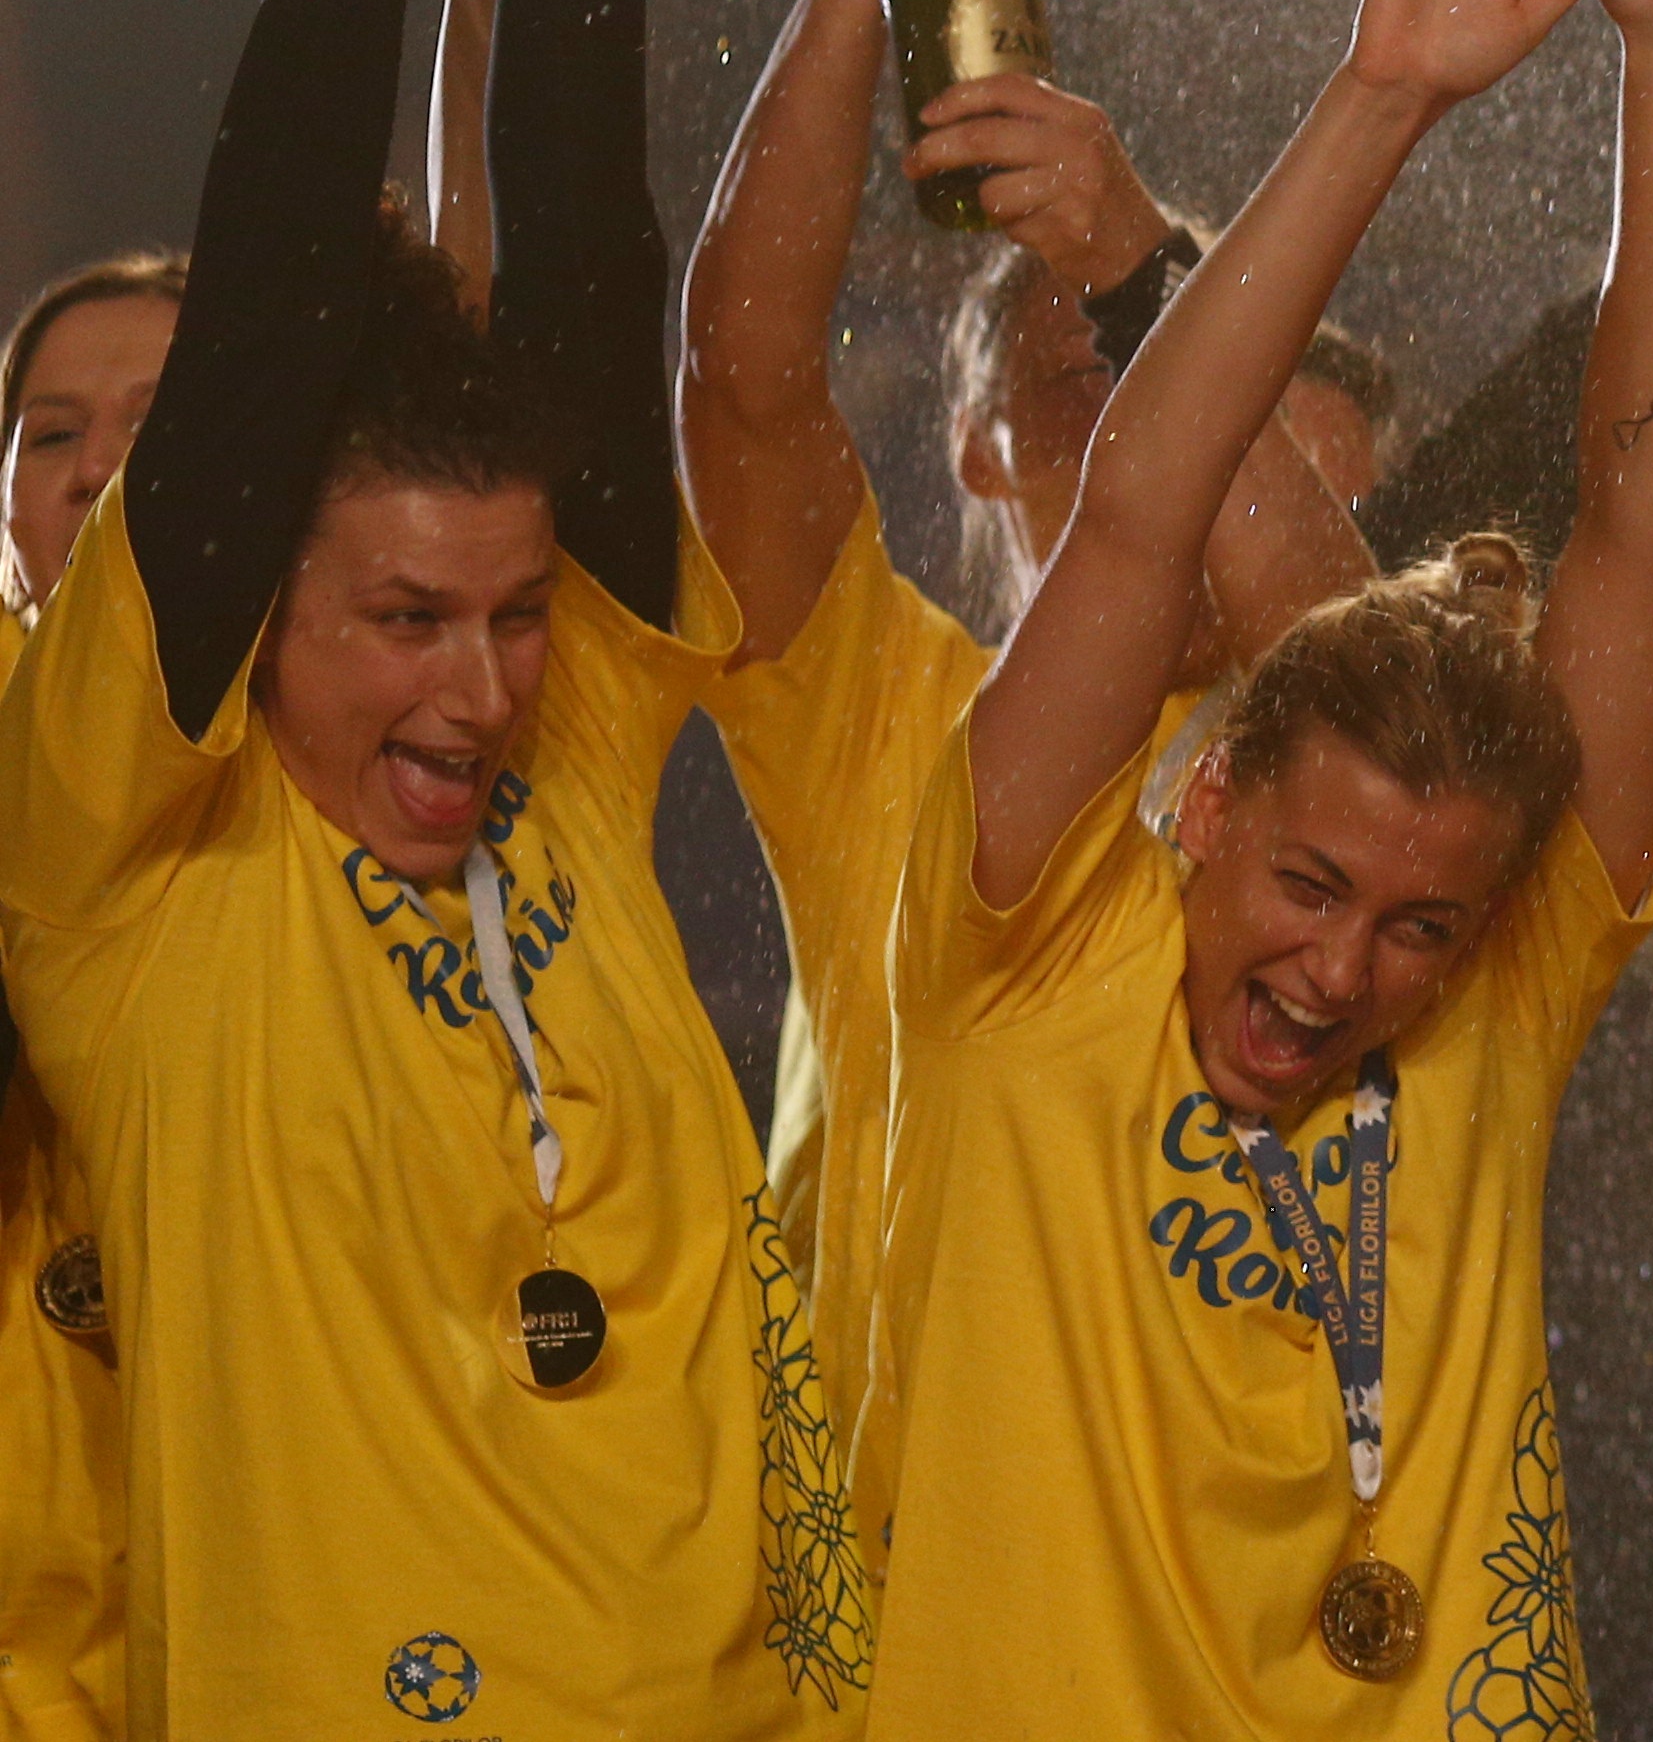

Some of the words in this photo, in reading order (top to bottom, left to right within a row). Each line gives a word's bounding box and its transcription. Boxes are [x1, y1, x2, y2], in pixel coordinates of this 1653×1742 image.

[1268, 1170, 1332, 1283] FLORILOR
[1359, 1160, 1381, 1282] FLORILOR
[1322, 1290, 1349, 1347] LIGA
[1358, 1290, 1379, 1346] LIGA
